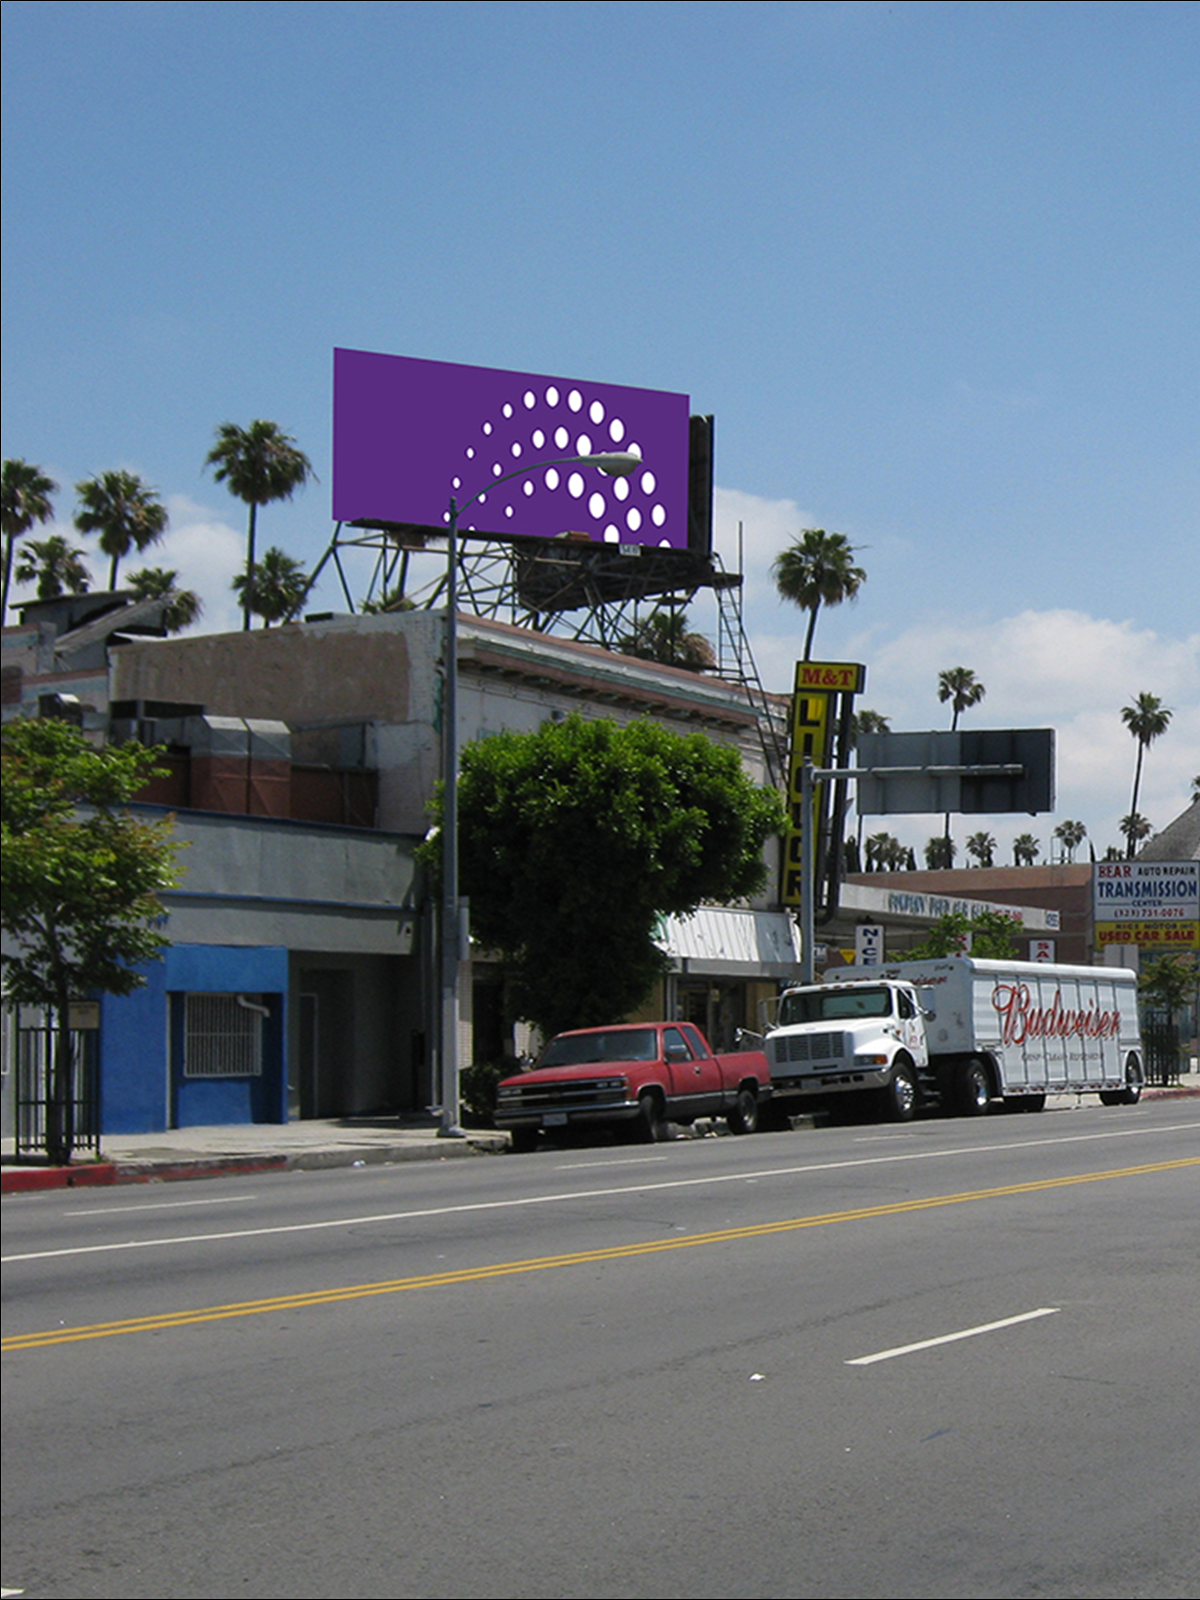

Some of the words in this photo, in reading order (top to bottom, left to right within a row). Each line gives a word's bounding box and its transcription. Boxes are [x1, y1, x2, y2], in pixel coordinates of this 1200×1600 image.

[801, 667, 853, 687] M&T
[1098, 865, 1132, 878] BEAR
[1137, 866, 1160, 876] AUTO
[1163, 866, 1196, 875] REPAIR
[1098, 881, 1197, 898] TRANSMISSION
[1098, 931, 1132, 941] USED
[1135, 931, 1160, 941] CAR
[1164, 930, 1195, 941] SALE
[991, 983, 1121, 1045] Budweiser
